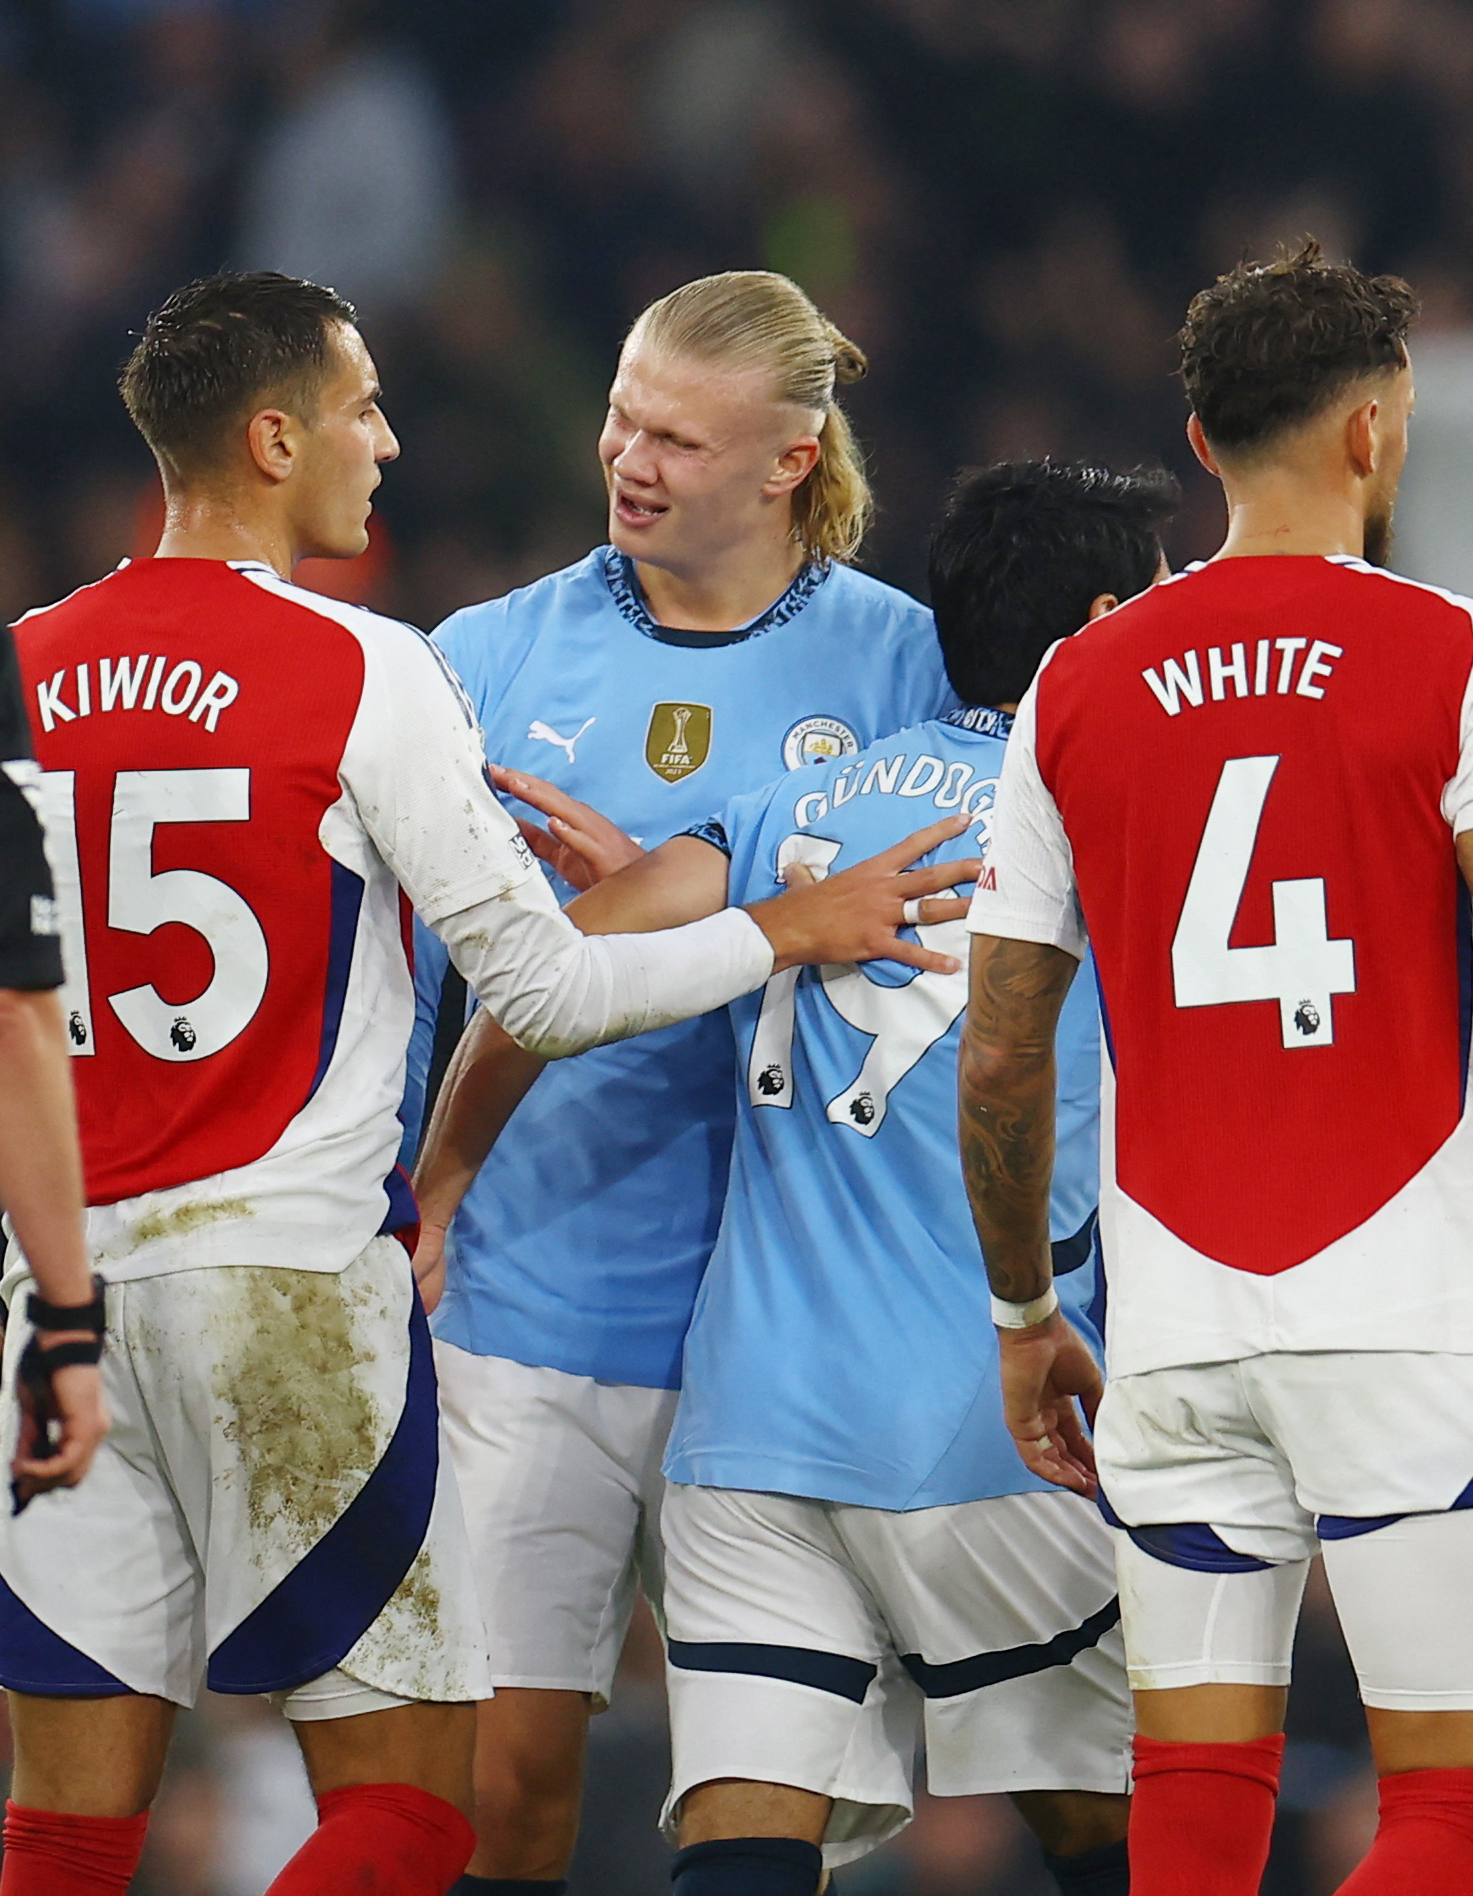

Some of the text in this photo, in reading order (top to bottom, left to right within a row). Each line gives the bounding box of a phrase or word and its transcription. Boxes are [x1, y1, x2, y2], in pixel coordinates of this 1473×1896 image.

[36, 653, 240, 733] KIWIOR
[1141, 636, 1344, 717] WHITE
[660, 753, 691, 765] FIFA
[791, 720, 854, 748] MANCHESTER
[38, 767, 270, 1063] 15
[1171, 754, 1357, 1050] 4
